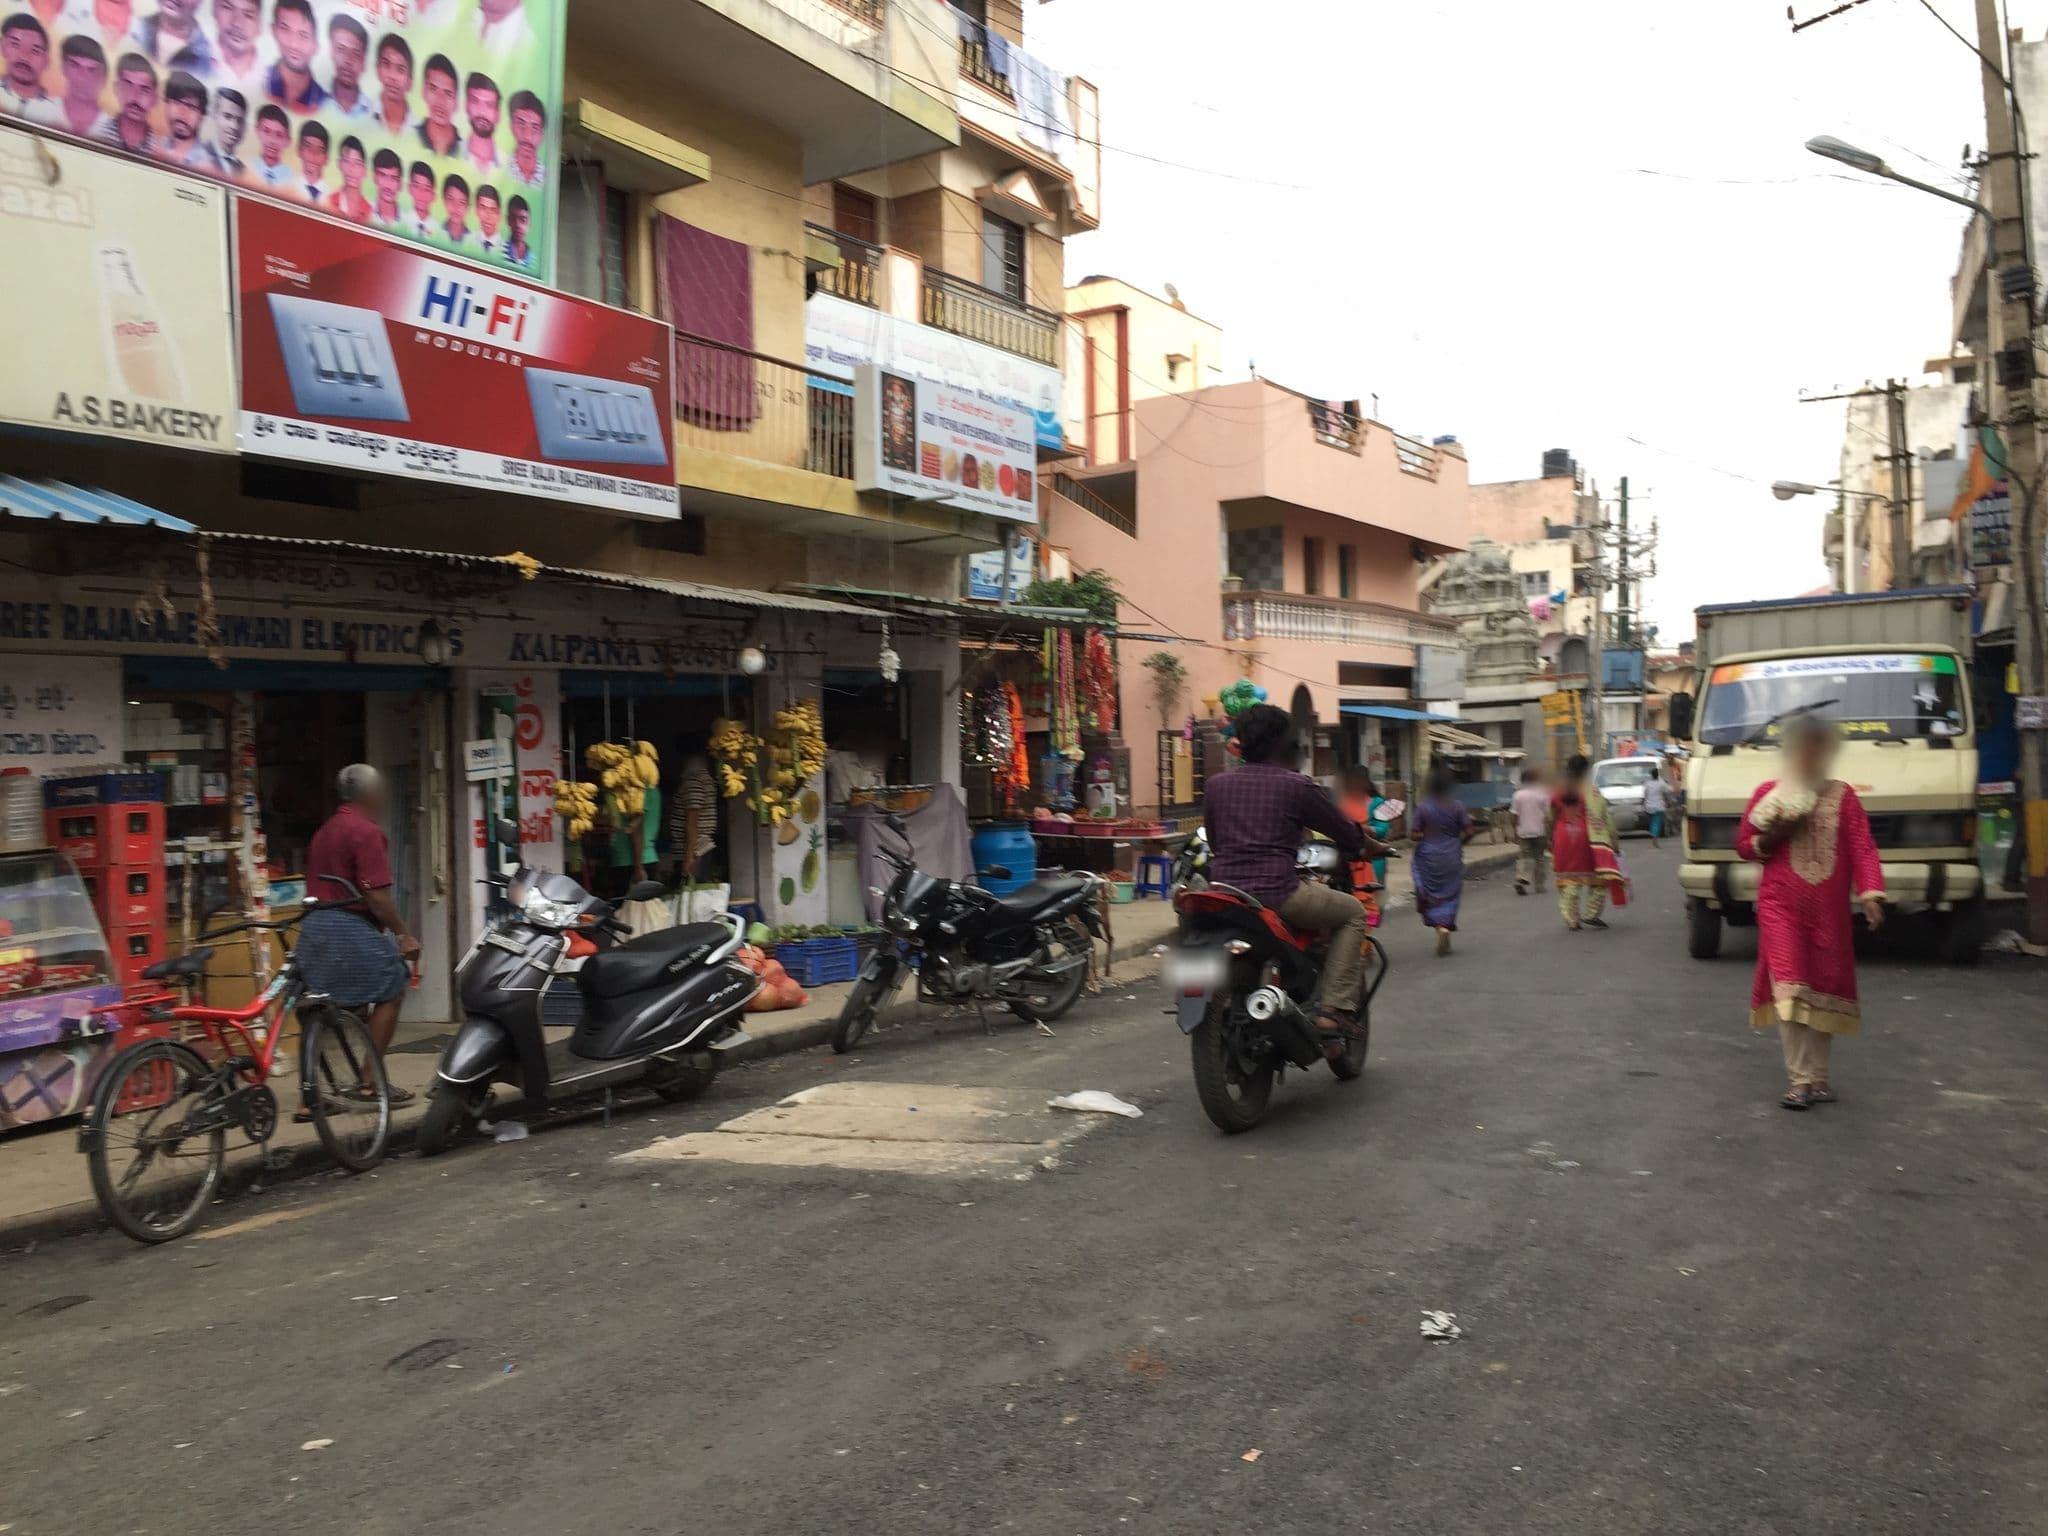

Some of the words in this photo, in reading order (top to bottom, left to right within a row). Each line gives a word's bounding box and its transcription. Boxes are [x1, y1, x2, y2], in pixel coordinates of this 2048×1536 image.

[421, 275, 529, 342] Hi-Fi
[414, 330, 522, 367] MODULAR
[55, 391, 222, 442] A.S.BAKERY
[510, 632, 642, 666] KALPANA
